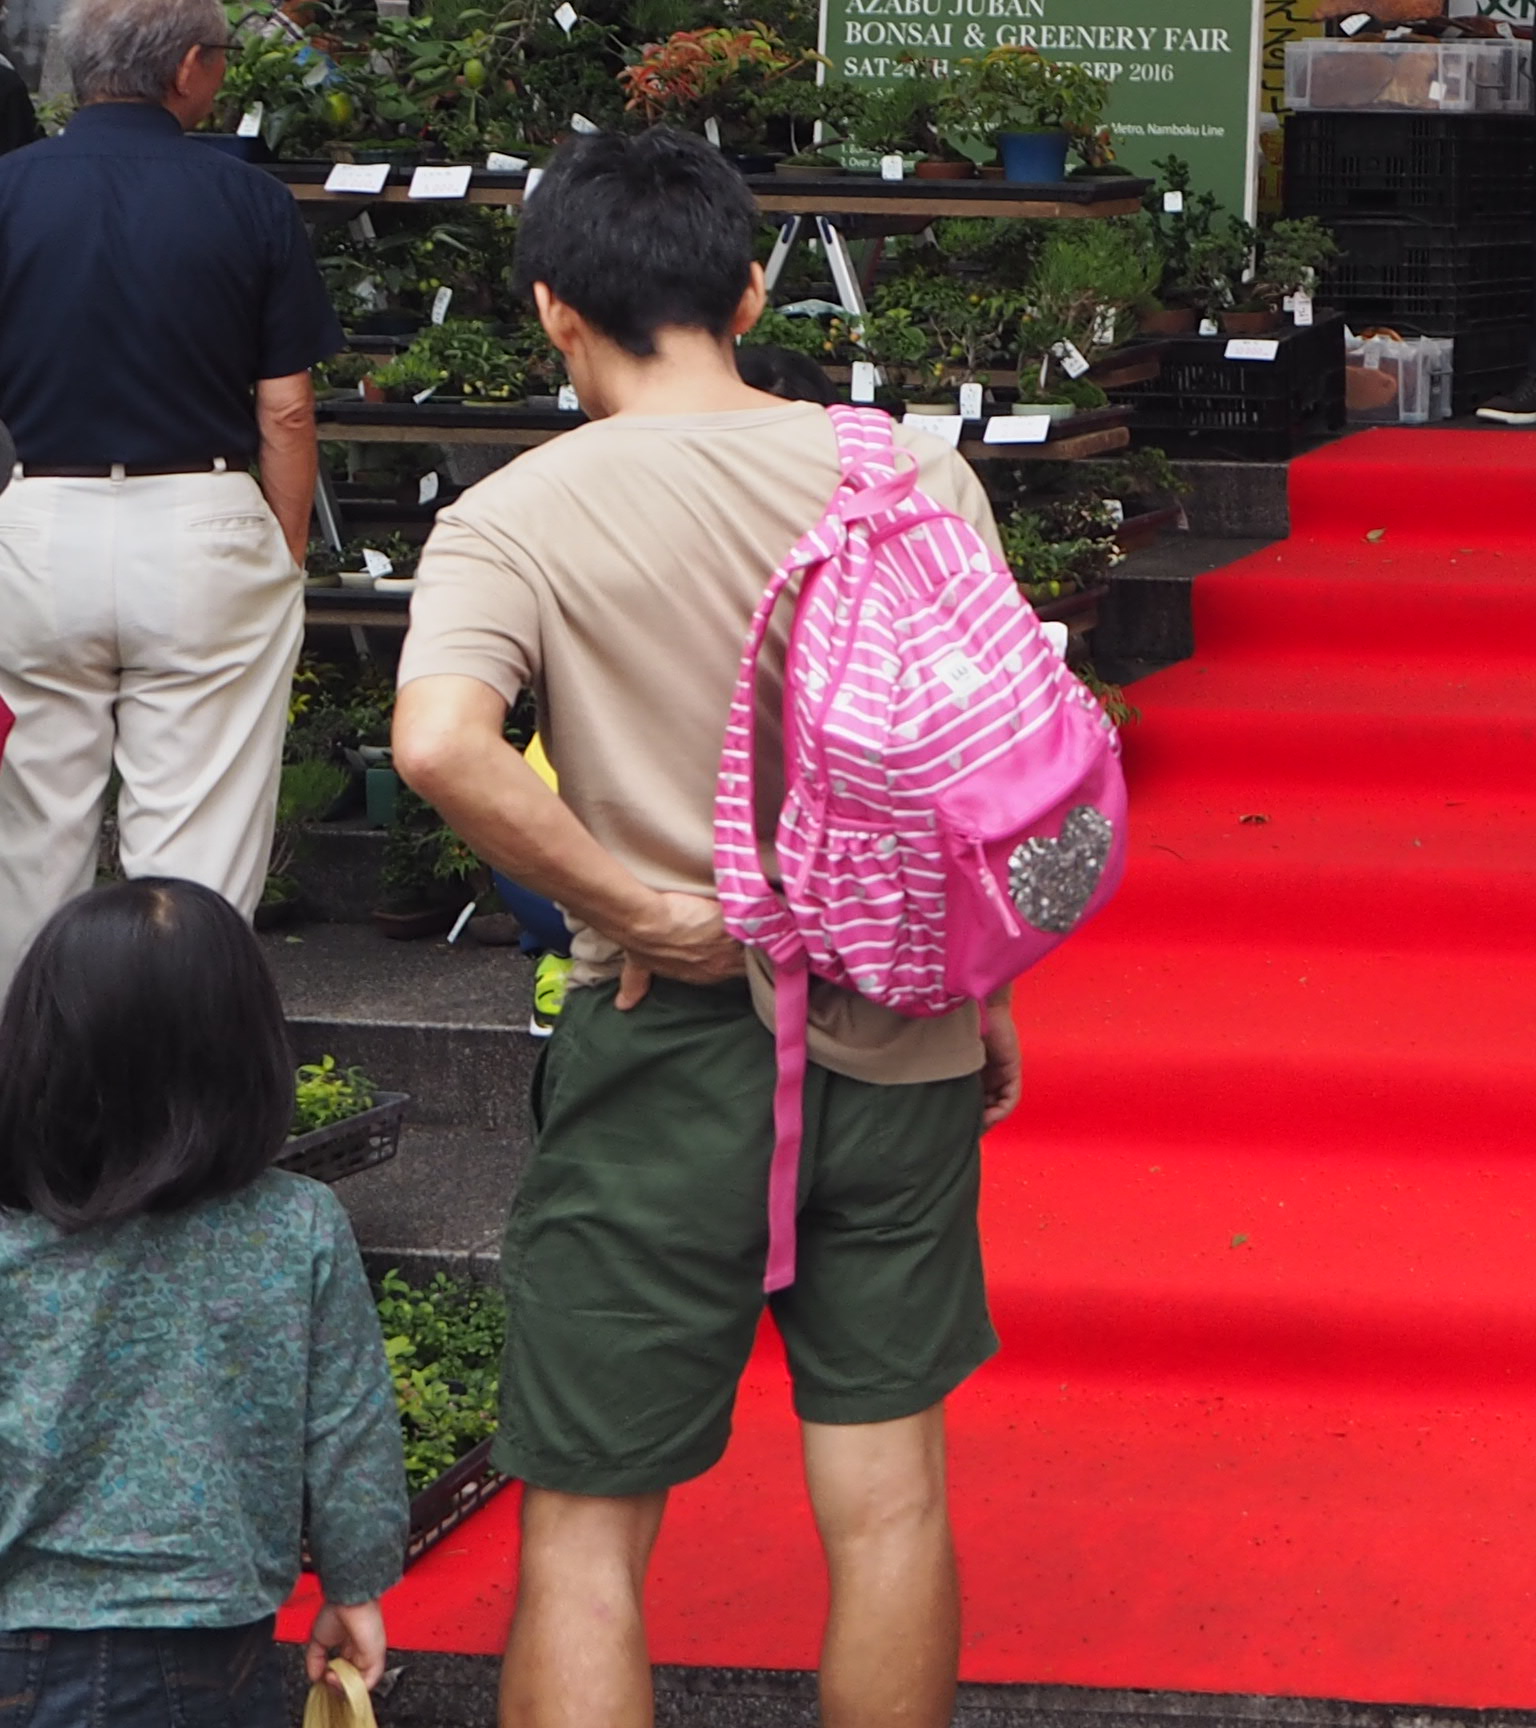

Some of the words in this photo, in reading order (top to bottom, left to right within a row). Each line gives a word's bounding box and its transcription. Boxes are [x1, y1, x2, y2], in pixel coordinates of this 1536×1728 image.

[844, 21, 953, 46] BONSAI
[963, 23, 986, 48] &
[996, 24, 1157, 51] GREENERY
[1164, 28, 1231, 51] FAIR
[844, 56, 889, 77] SAT
[1129, 62, 1174, 82] 2016
[1147, 123, 1199, 137] Namboku
[1201, 124, 1225, 137] Line
